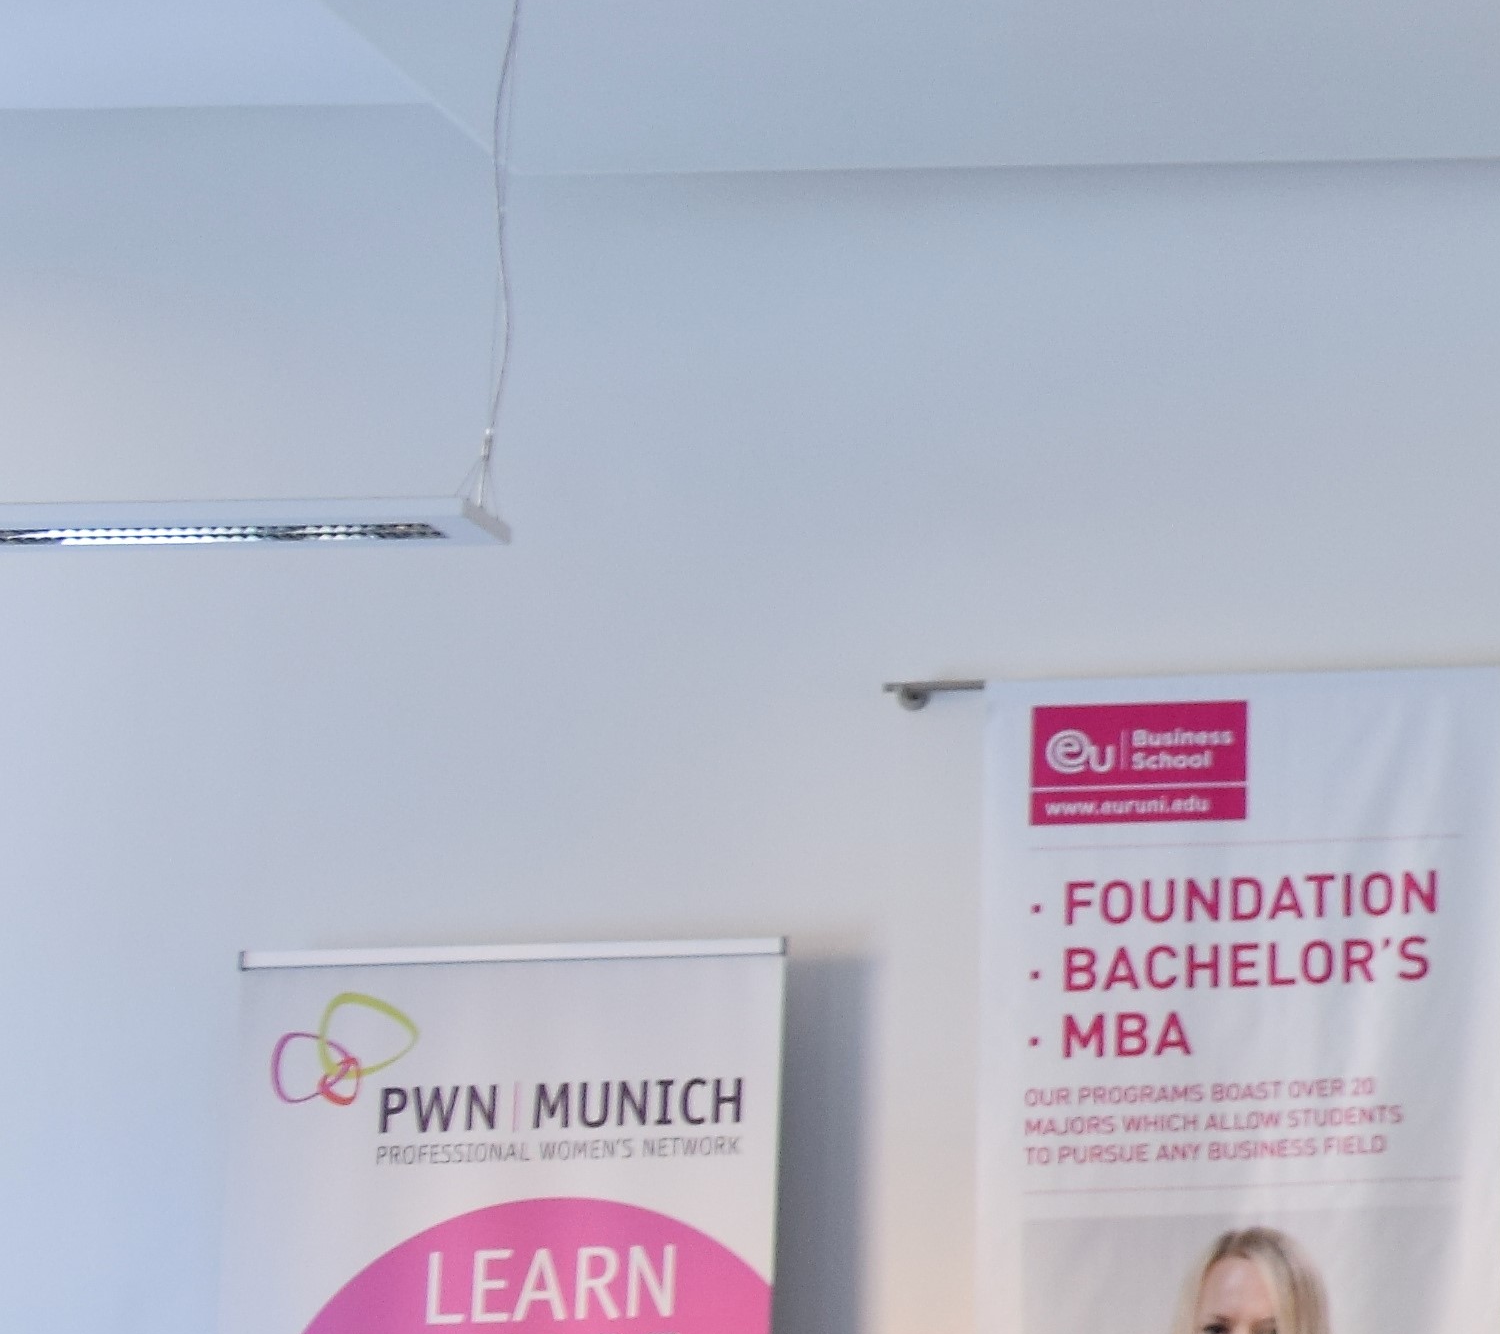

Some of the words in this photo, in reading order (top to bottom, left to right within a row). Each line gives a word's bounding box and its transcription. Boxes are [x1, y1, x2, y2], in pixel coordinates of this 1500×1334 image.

[1131, 726, 1235, 748] Business
[1130, 749, 1212, 771] School
[1045, 795, 1211, 818] www.euruni.edu
[1063, 870, 1440, 926] FOUNDATION
[1062, 936, 1431, 993] BACHELOR'S
[1061, 1012, 1193, 1059] MBA
[378, 1085, 498, 1134] PWN
[532, 1077, 746, 1129] MUNICH
[1024, 1087, 1072, 1107] OUR
[1077, 1082, 1204, 1106] PROGRAMS
[1210, 1080, 1283, 1103] BOAST
[1288, 1078, 1345, 1100] OVER
[1351, 1077, 1376, 1097] 20
[1024, 1115, 1116, 1137] MAJORS
[1122, 1112, 1198, 1134] WHICH
[1204, 1109, 1282, 1131] ALLOW
[1286, 1105, 1405, 1130] STUDENTS
[375, 1144, 531, 1166] PROFESSIONAL
[540, 1140, 635, 1161] WOMEN'S
[642, 1135, 743, 1158] NETWORK
[1024, 1146, 1051, 1166] TO
[1057, 1142, 1150, 1165] PURSUE
[1156, 1141, 1202, 1162] ANY
[1207, 1137, 1318, 1160] BUSINESS
[1322, 1134, 1389, 1156] FIELD
[425, 1244, 679, 1325] LEARN
